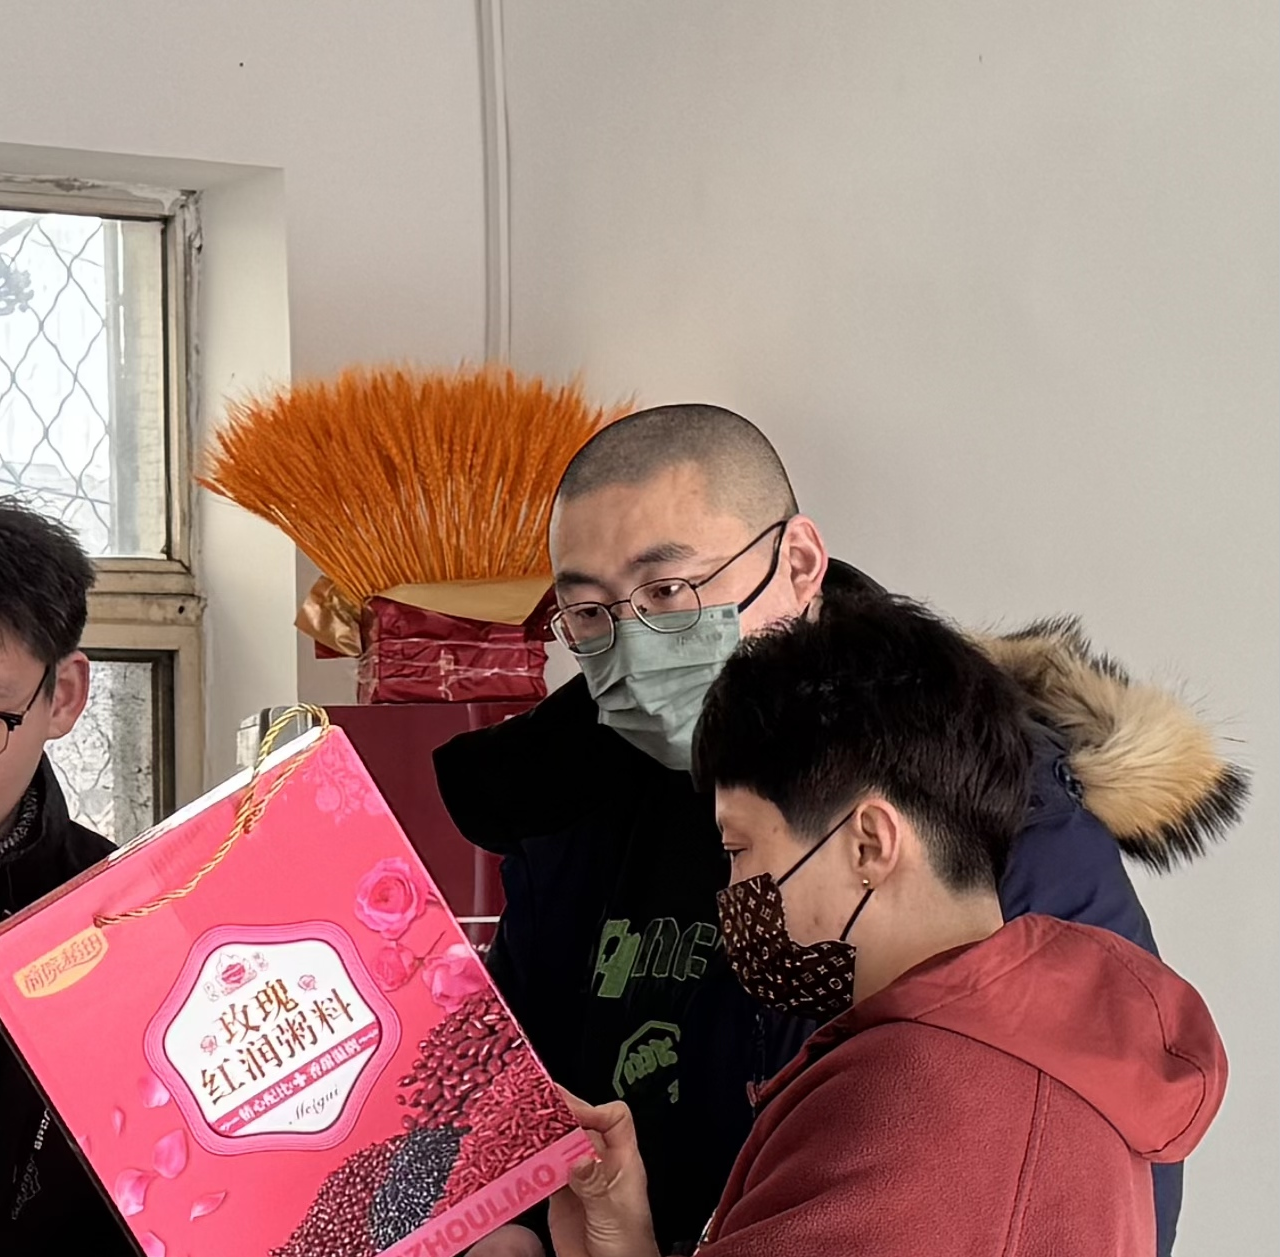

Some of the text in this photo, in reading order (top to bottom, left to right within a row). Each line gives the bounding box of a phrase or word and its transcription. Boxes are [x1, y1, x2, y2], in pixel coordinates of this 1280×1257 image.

[201, 988, 354, 1106] 红润粥料
[214, 978, 300, 1044] 玫瑰
